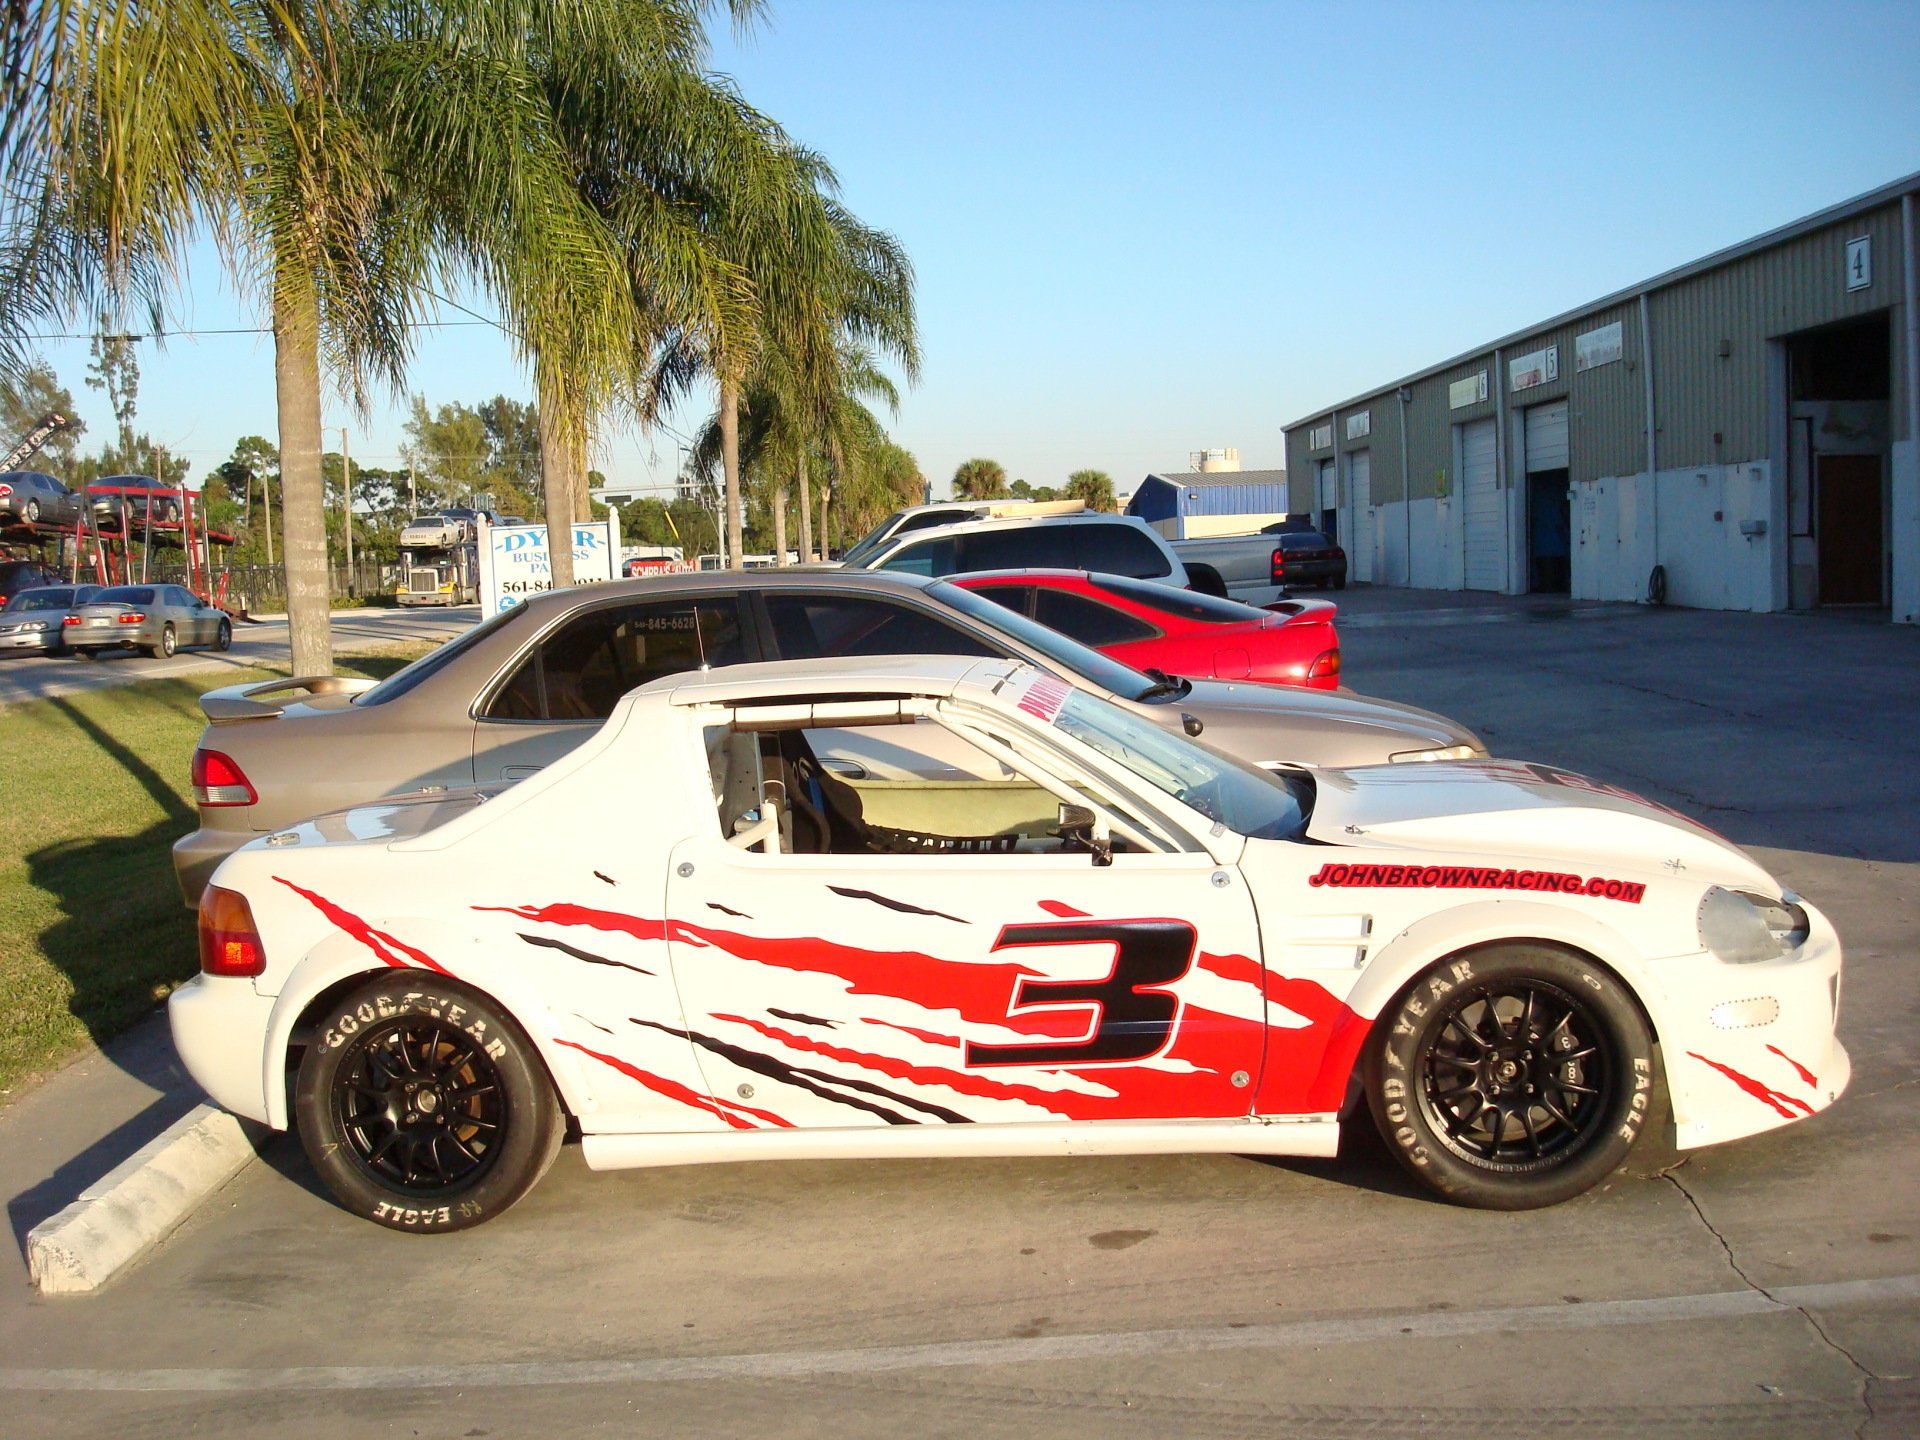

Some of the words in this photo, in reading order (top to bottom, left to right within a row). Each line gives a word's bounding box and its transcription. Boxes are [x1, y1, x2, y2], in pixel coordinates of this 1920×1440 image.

[1853, 248, 1863, 279] 4
[513, 550, 589, 563] BUSISS
[531, 563, 549, 574] PA
[1309, 864, 1646, 904] JOHNBROWNRACING.COM
[964, 917, 1197, 1068] 3
[1619, 1057, 1650, 1144] EAGLE
[373, 1201, 451, 1226] EAGLE
